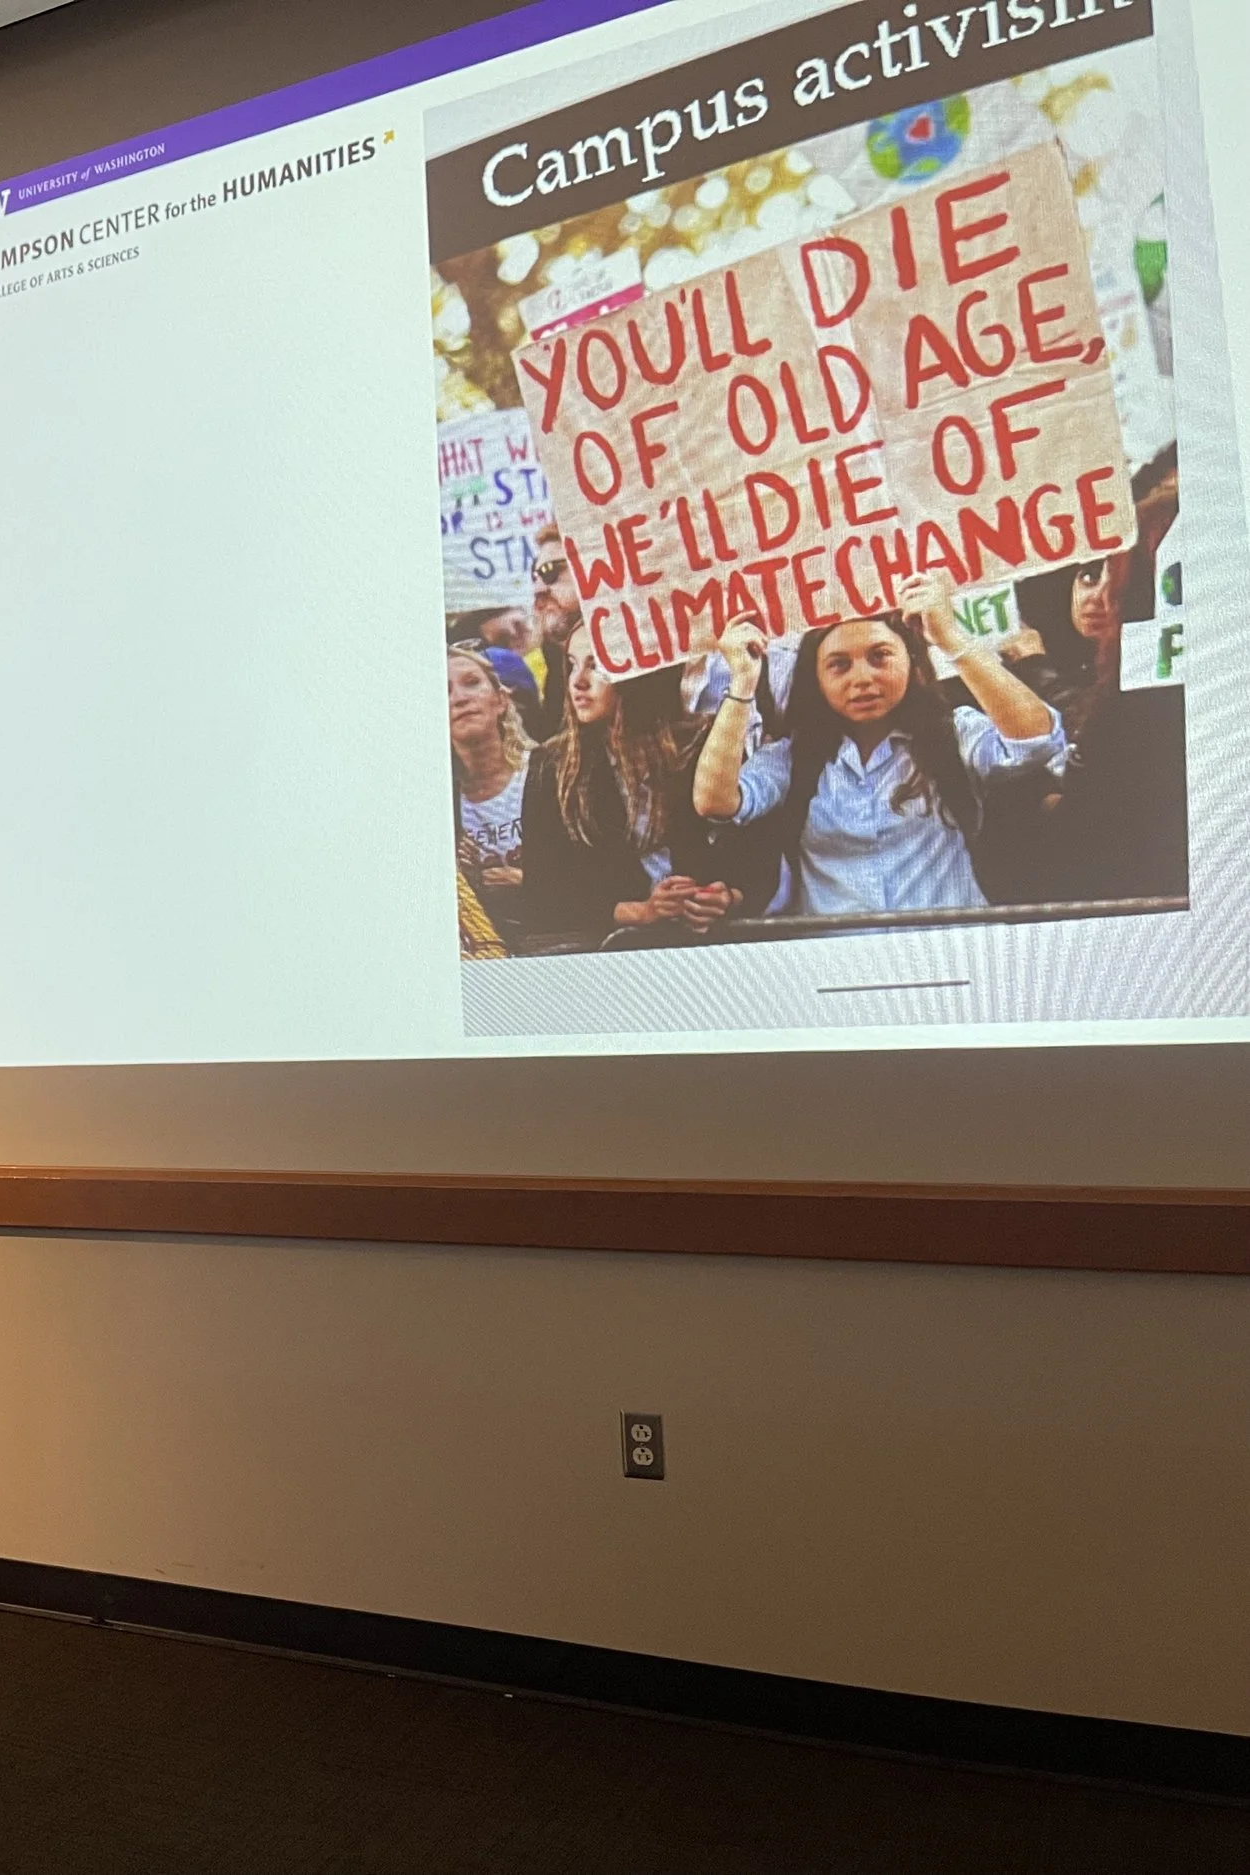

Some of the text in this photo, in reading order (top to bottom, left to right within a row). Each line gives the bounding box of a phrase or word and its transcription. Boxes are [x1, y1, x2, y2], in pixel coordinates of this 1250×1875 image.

[18, 143, 165, 200] UNIVERSITY of WASHINGTON
[79, 203, 160, 245] CENTER
[165, 200, 186, 219] for
[190, 193, 216, 212] the
[222, 137, 375, 203] HUMANITIES
[482, 80, 769, 207] Campus
[29, 274, 44, 289] OF
[46, 265, 74, 284] ARTS
[77, 262, 84, 275] &
[88, 246, 140, 272] SCIENCES
[520, 172, 1021, 434] YOU'LL DIE
[573, 263, 1107, 506] OF OLD AGE,
[564, 378, 1065, 600] WE'LL DIE OF
